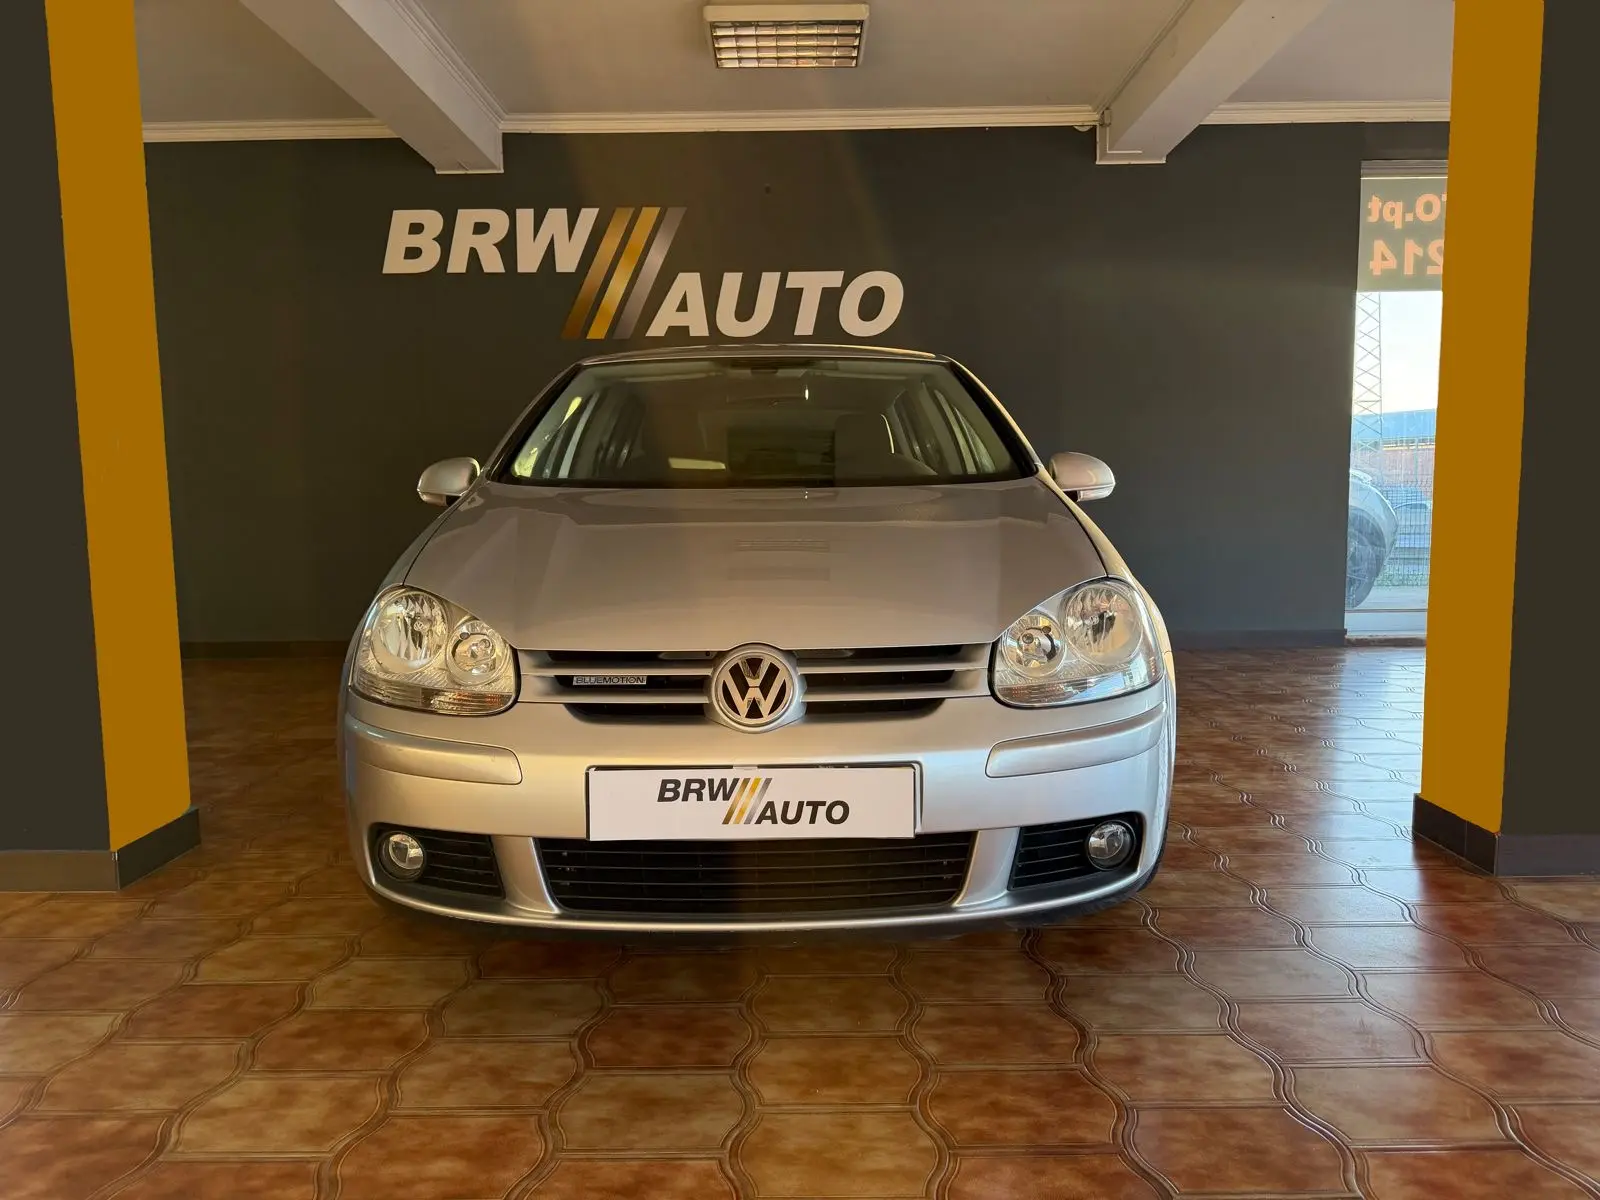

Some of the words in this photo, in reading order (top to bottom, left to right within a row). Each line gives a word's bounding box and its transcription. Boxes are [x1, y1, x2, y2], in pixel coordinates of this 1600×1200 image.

[382, 208, 599, 274] BRW
[646, 270, 904, 337] AUTO
[574, 675, 646, 685] BLUEMOTION
[719, 657, 789, 720] VW
[657, 777, 739, 802] BRW
[755, 800, 850, 825] AUTO
